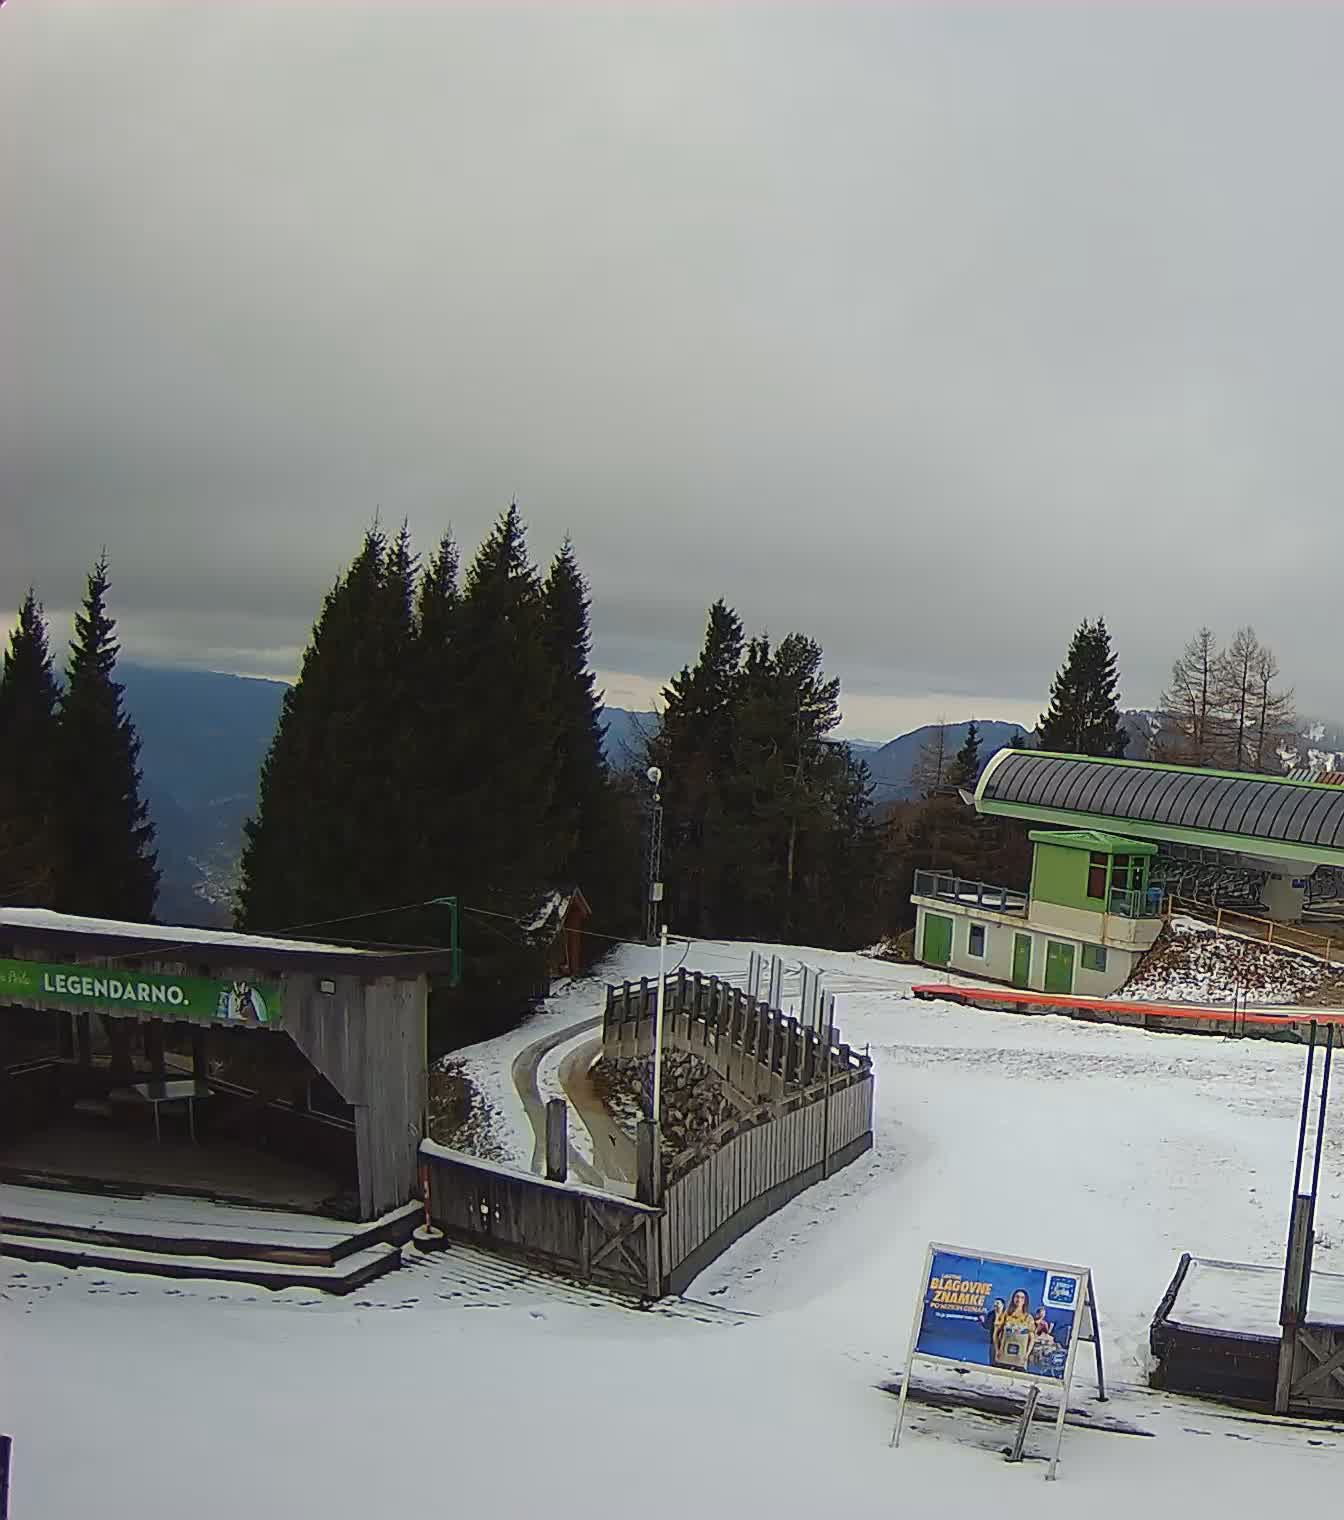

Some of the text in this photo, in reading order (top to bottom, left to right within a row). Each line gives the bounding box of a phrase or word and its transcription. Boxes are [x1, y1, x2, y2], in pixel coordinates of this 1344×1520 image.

[43, 972, 190, 1006] LEGENDARNO.
[930, 1277, 993, 1295] BLAGOVNE
[932, 1290, 985, 1305] ZNAMKE
